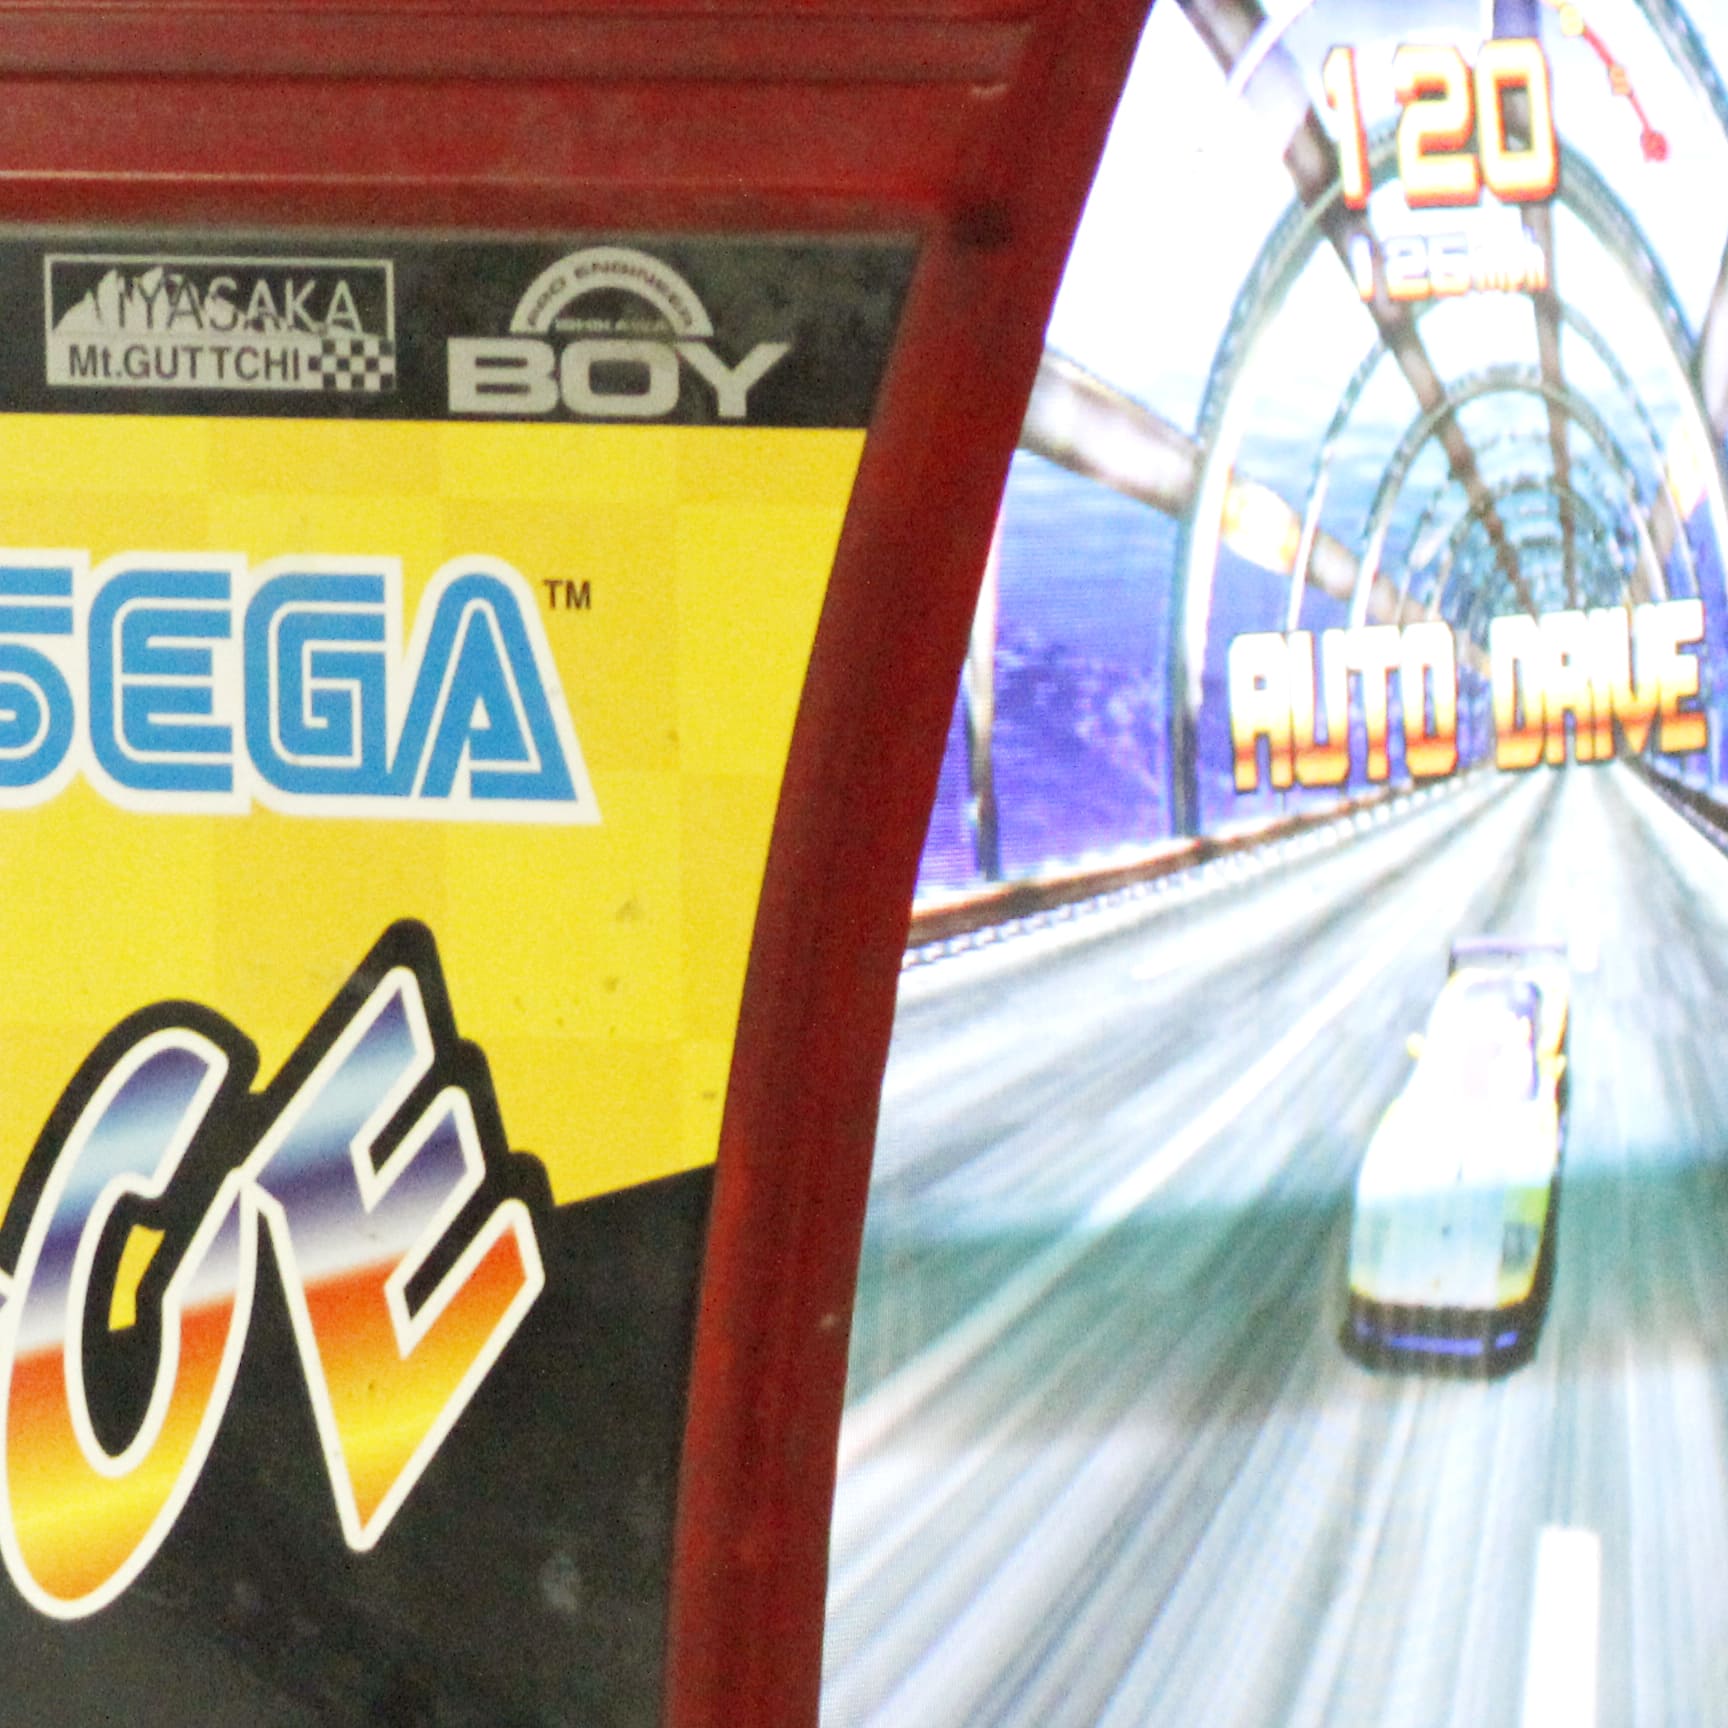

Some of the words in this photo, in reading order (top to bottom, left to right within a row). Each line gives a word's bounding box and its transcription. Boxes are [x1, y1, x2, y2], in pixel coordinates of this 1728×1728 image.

[1322, 38, 1560, 211] 120
[447, 336, 791, 419] BOY
[1227, 620, 1458, 792] AUTO
[1489, 598, 1708, 772] DRIVE
[0, 962, 546, 1621] CE
